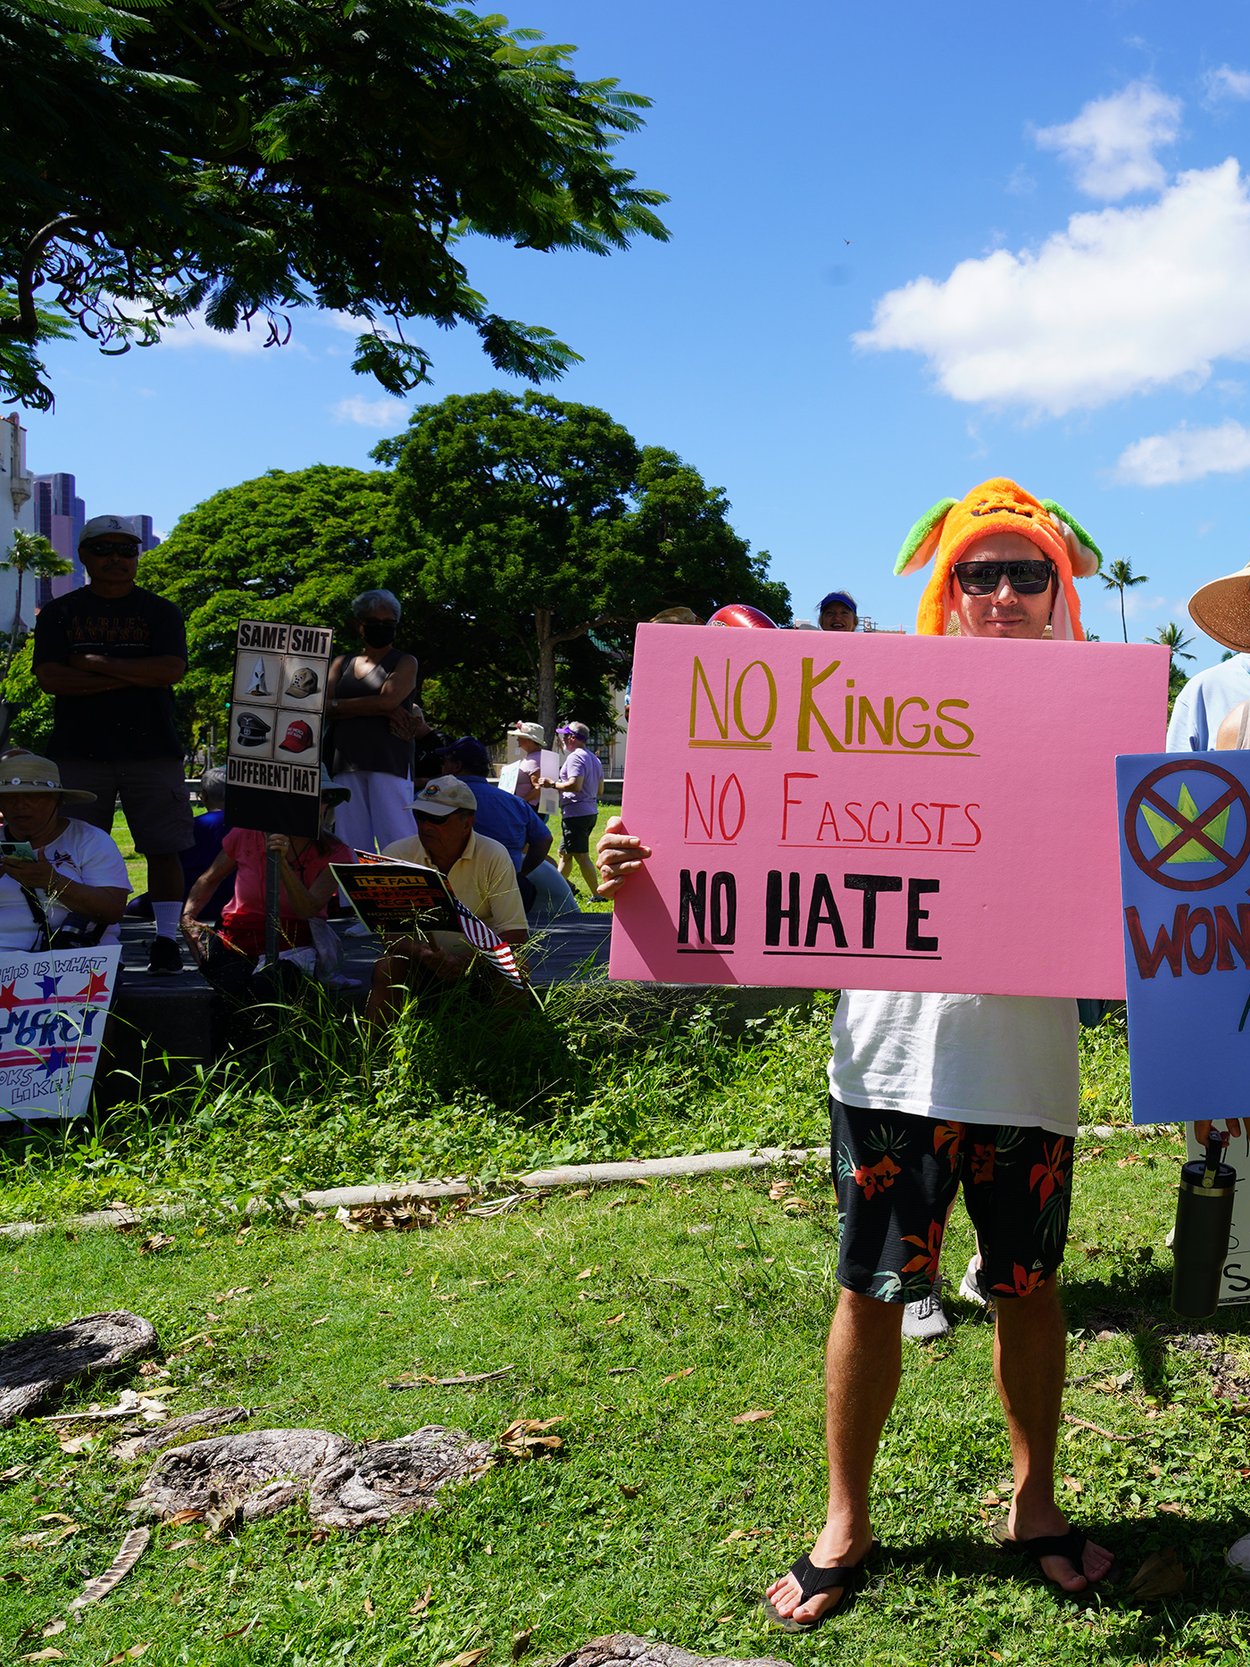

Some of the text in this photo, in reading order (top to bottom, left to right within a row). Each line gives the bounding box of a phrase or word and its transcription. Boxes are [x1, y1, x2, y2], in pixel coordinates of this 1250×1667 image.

[240, 623, 330, 655] SAME SHIT
[689, 655, 778, 741] NO
[228, 759, 317, 793] DIFFERENT HAT
[683, 771, 982, 847] NO FASCISTS
[356, 877, 427, 886] THE FALL
[677, 868, 943, 953] NO HATE
[0, 956, 108, 984] HIS IS WHAT
[0, 1068, 35, 1087] OKS
